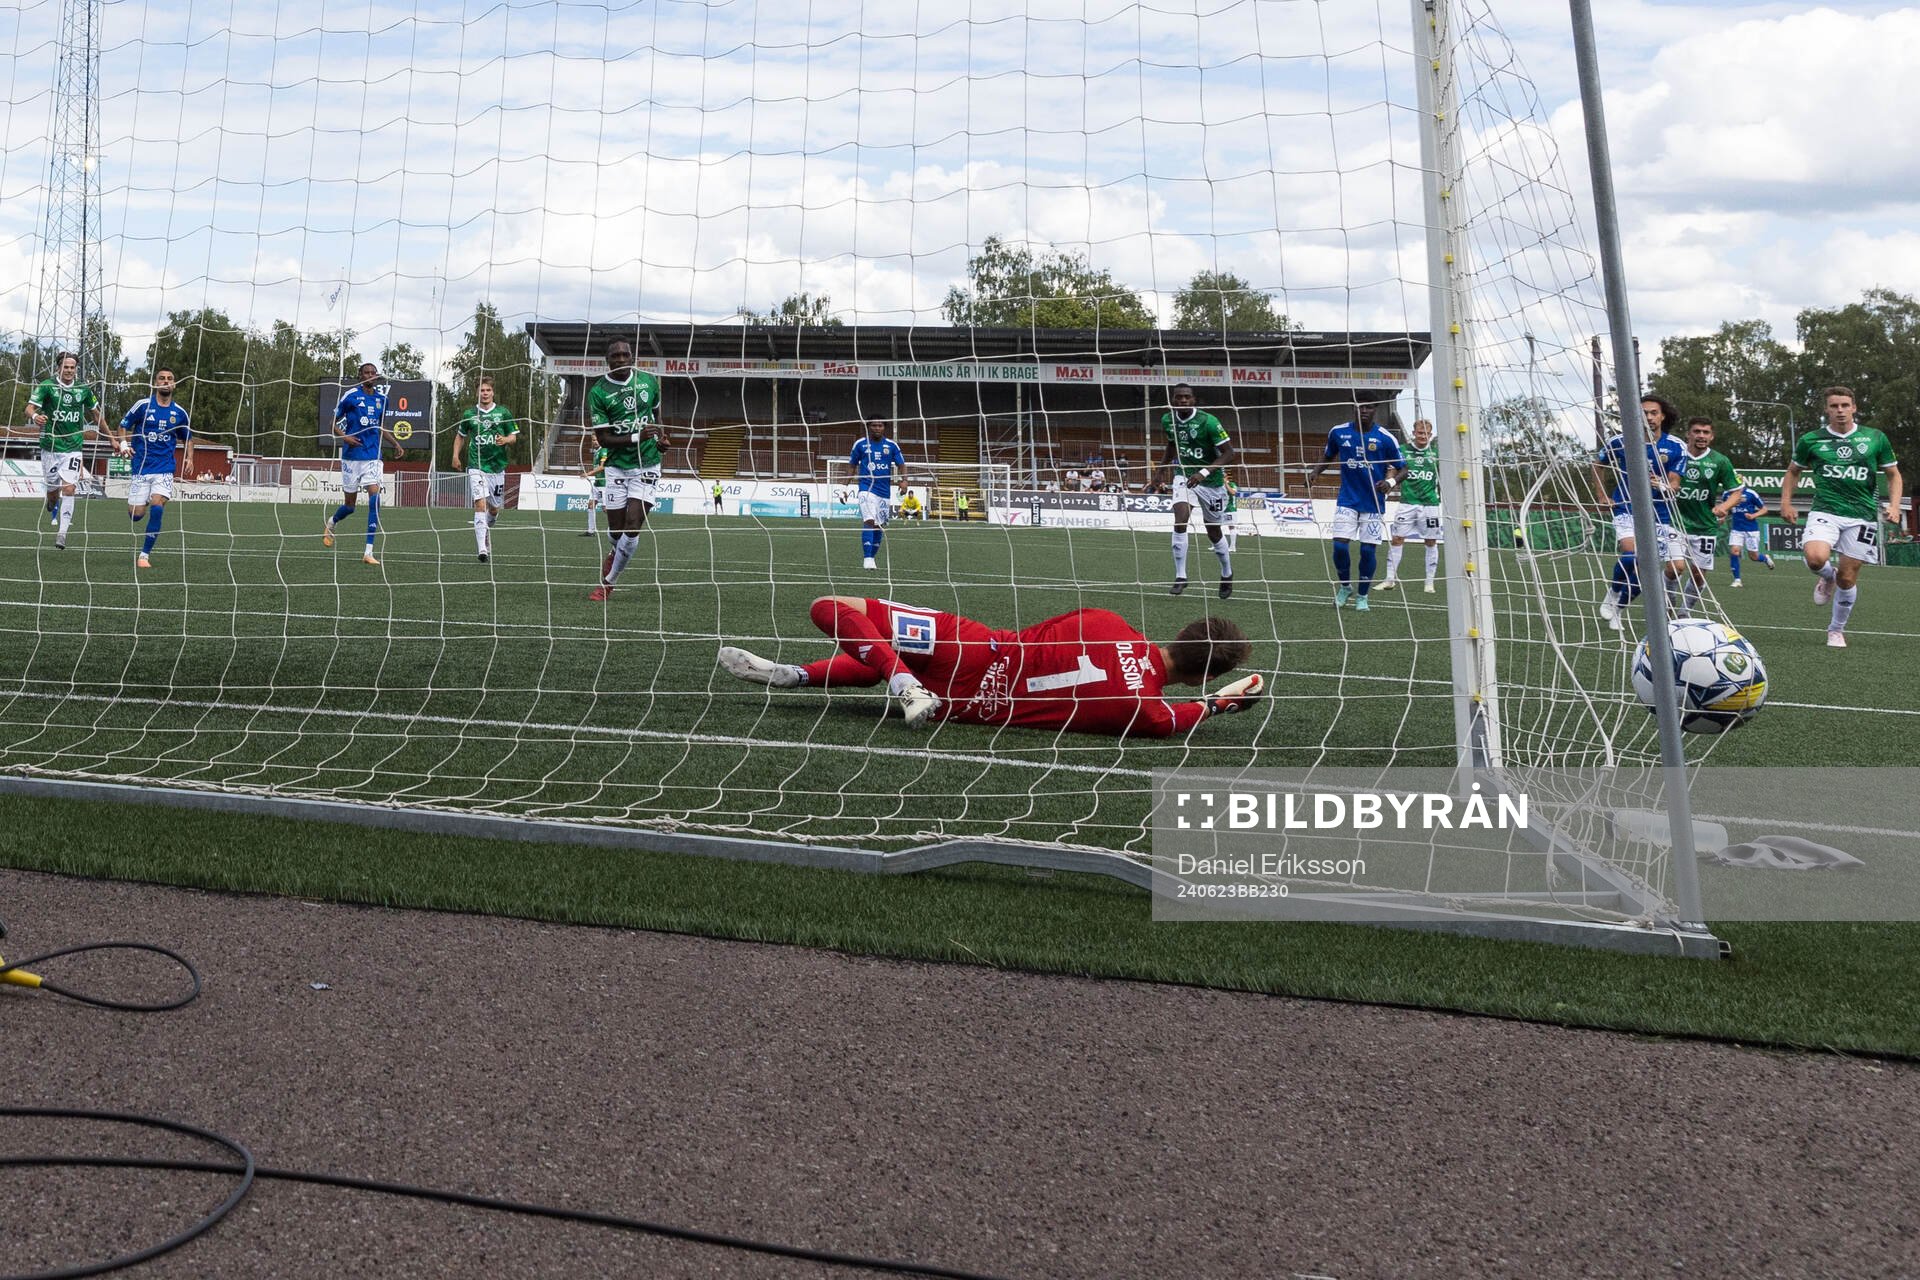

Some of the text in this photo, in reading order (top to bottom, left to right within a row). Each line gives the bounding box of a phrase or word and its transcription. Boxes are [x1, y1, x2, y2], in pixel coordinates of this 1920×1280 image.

[878, 365, 954, 378] TILLSAMMANS
[956, 364, 972, 378] ÄR
[988, 367, 999, 378] IK
[1002, 366, 1039, 379] BRAGE
[1055, 366, 1094, 378] MAXI
[1232, 368, 1272, 381] MAXI
[399, 397, 408, 411] 0
[52, 410, 80, 423] SSAB
[1822, 464, 1869, 482] SSAB
[534, 479, 565, 490] SSAB
[770, 487, 802, 498] SSAB
[1278, 506, 1305, 515] VAR
[1021, 515, 1111, 528] VSTANHEDE
[1115, 641, 1145, 691] OLSSON
[1026, 654, 1109, 693] 1
